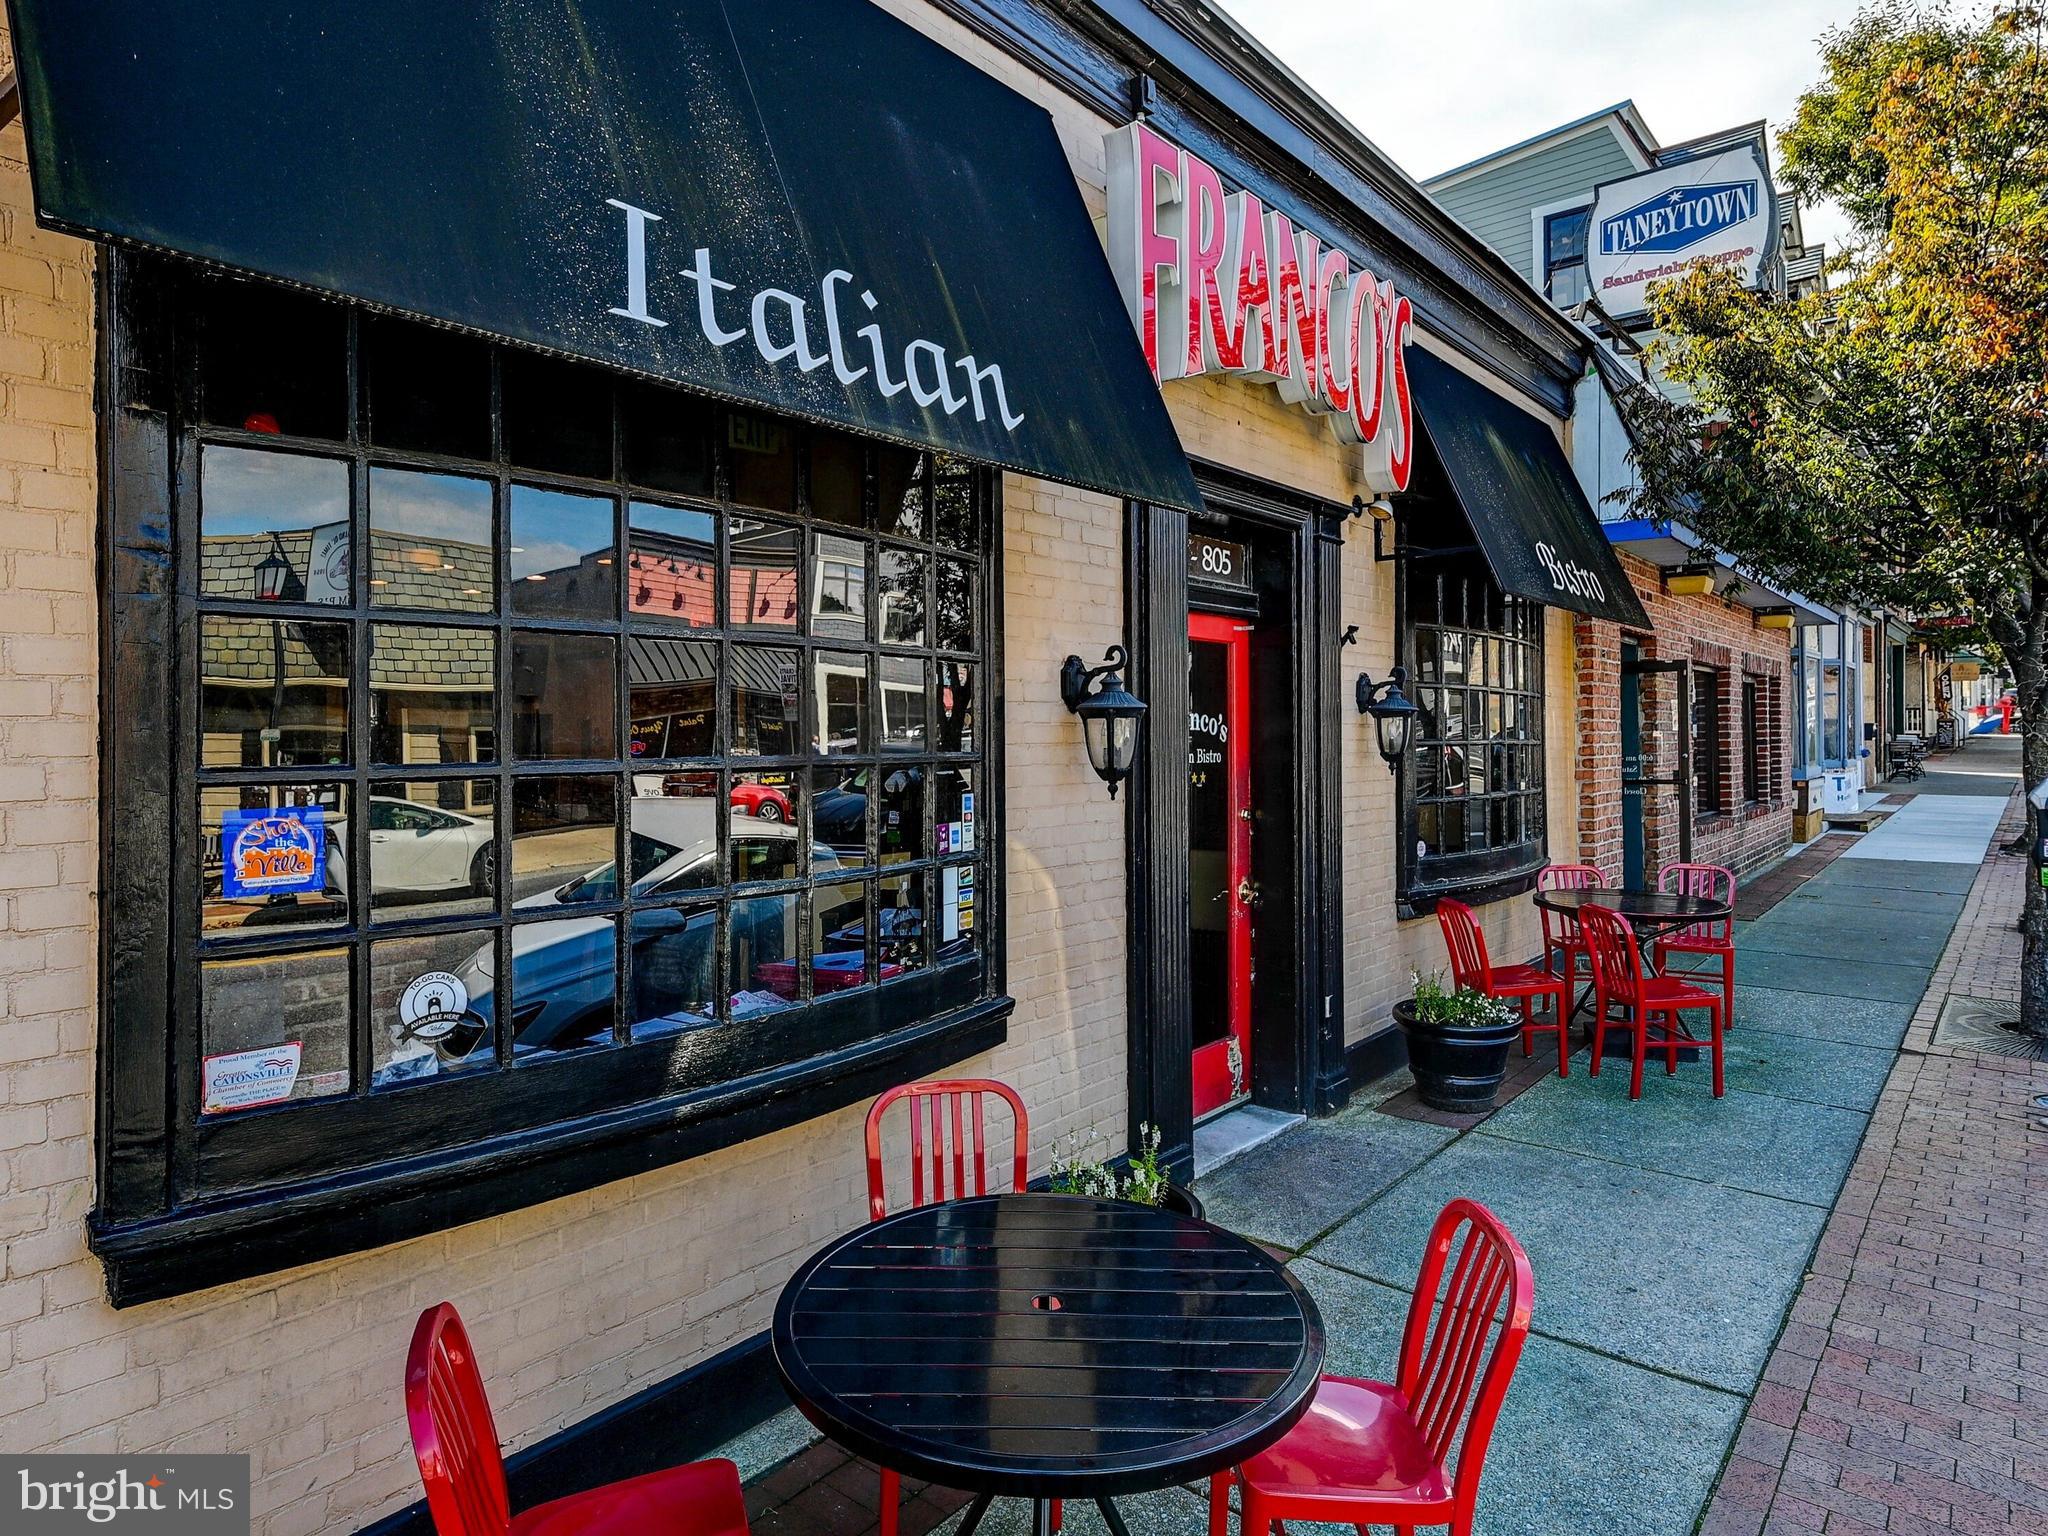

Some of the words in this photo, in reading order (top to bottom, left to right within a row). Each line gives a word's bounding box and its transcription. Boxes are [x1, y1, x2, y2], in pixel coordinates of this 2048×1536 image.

[1607, 184, 1751, 255] TANEYTOWN
[1602, 261, 1684, 290] Sandwich
[606, 198, 1025, 432] Italian
[1135, 122, 1413, 493] FRANCO'S
[1202, 545, 1231, 575] 805
[1536, 541, 1605, 603] Bistro
[1196, 748, 1222, 764] Bistro
[239, 816, 302, 846] Shop
[274, 837, 294, 848] the
[247, 854, 308, 877] Ville
[410, 974, 434, 991] TO-GO
[435, 973, 456, 985] CANS
[410, 1014, 443, 1030] AVAILABLE
[443, 1013, 461, 1021] HERE
[218, 1056, 239, 1065] Proud
[240, 1051, 267, 1062] Member
[212, 1065, 294, 1088] CATONSVILLE
[212, 1083, 247, 1095] Chamber
[247, 1081, 256, 1089] of
[256, 1076, 293, 1087] Commerce
[217, 1070, 248, 1081] Greater
